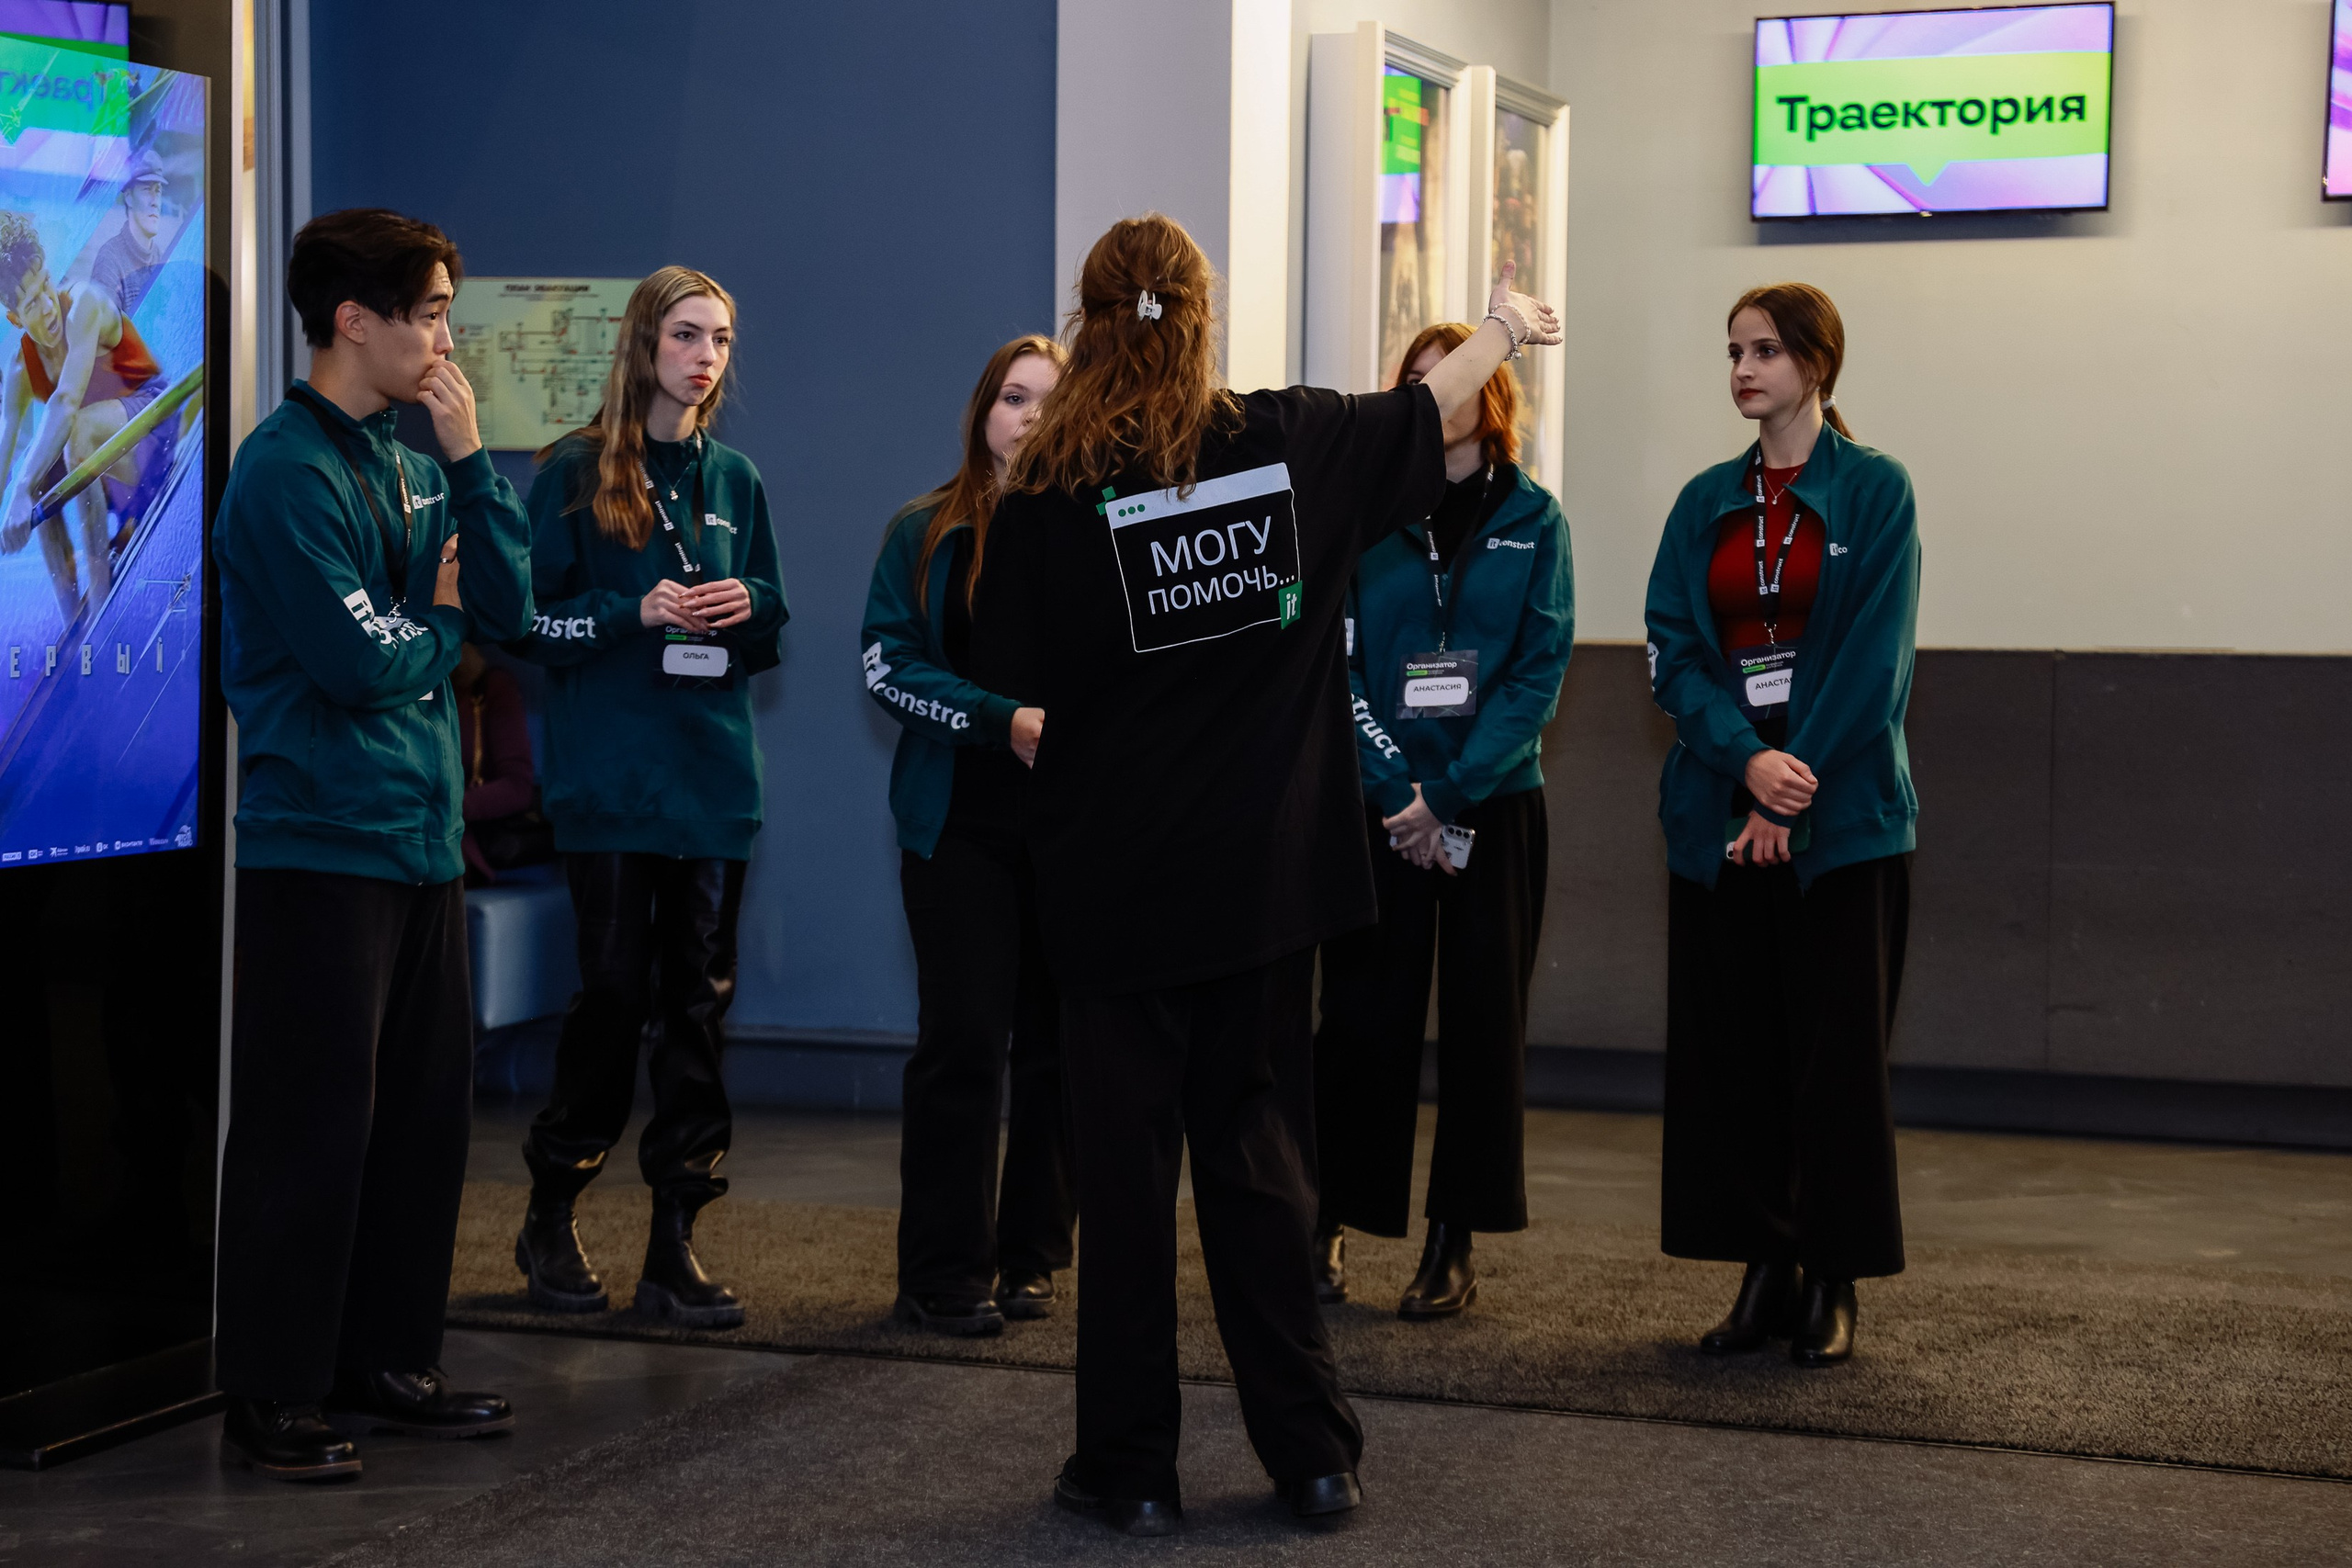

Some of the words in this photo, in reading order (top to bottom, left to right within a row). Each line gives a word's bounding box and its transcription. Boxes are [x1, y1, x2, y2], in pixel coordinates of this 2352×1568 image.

[1776, 95, 2086, 141] Траектория
[1150, 515, 1272, 577] МОГУ
[1286, 592, 1298, 620] it
[683, 651, 710, 660] ОЛЬГА
[1739, 650, 1796, 667] Организатор
[1407, 661, 1458, 671] Организатор
[1413, 683, 1462, 693] АНАСТАСИЯ
[1755, 677, 1792, 691] АНАСТА
